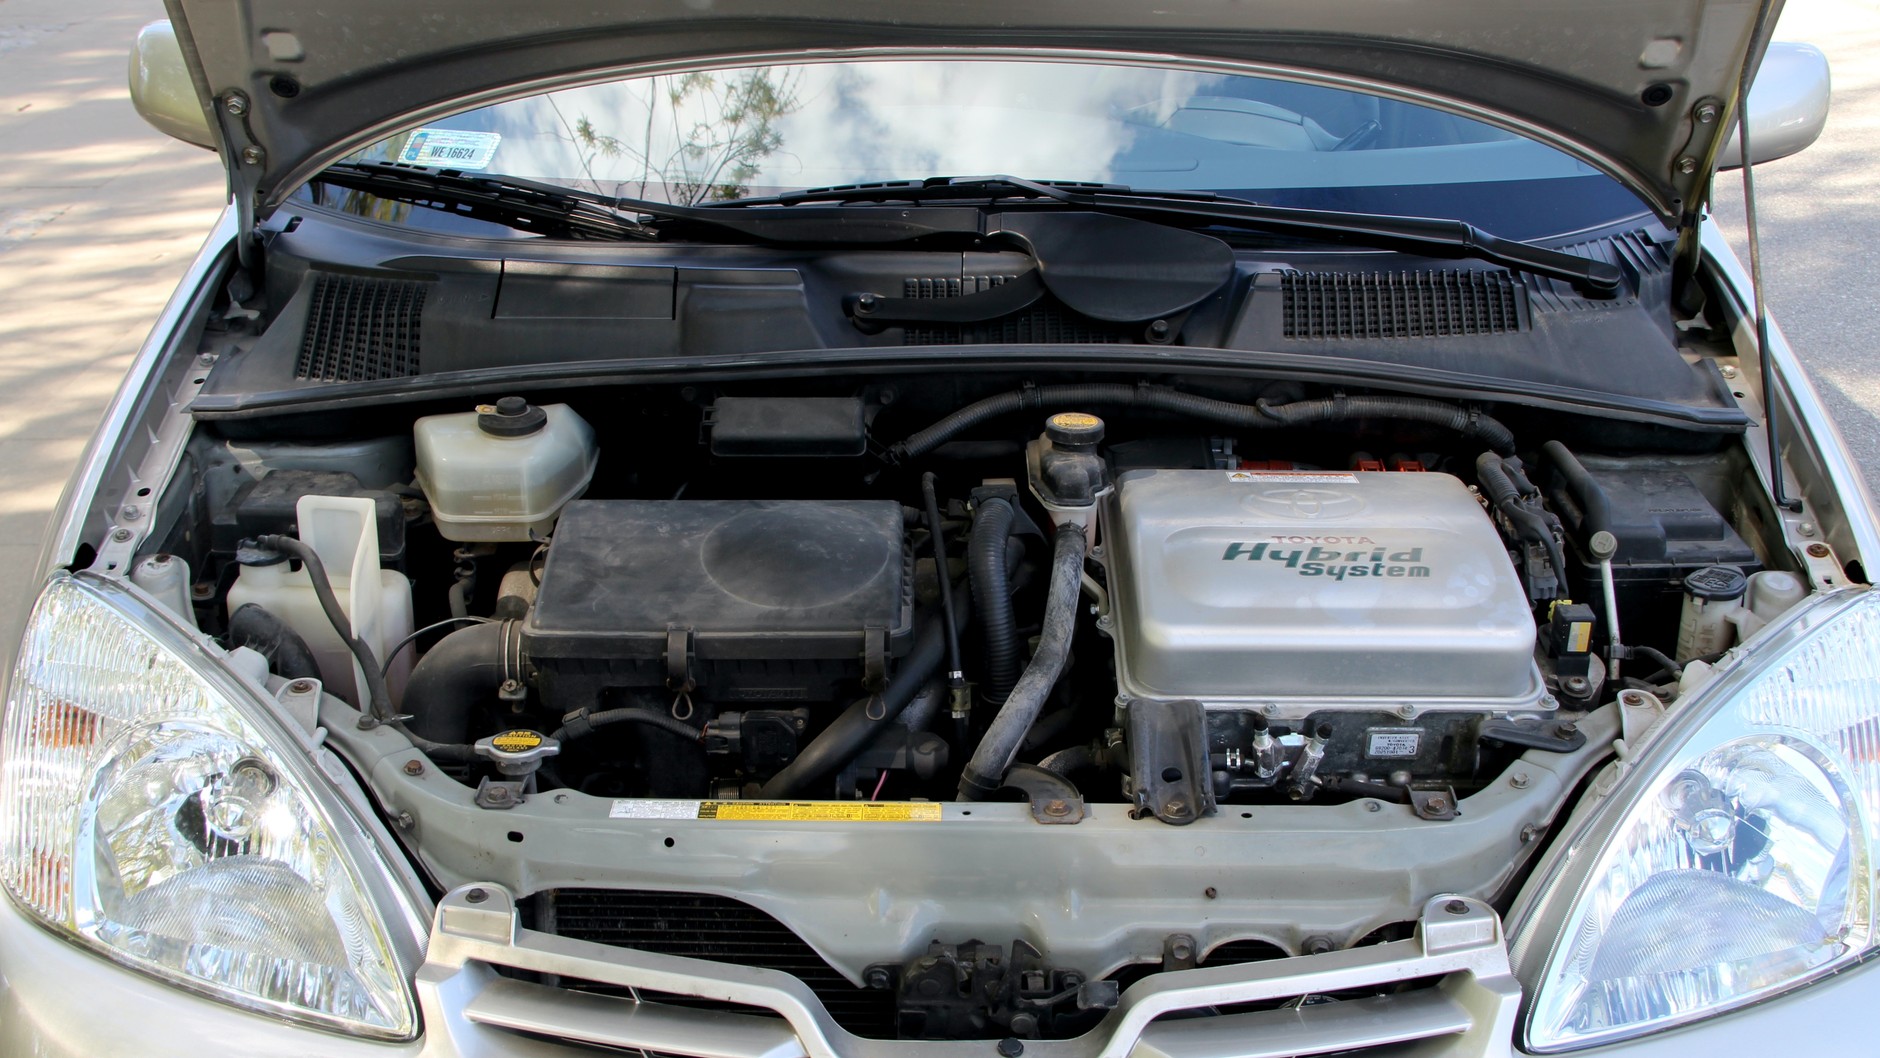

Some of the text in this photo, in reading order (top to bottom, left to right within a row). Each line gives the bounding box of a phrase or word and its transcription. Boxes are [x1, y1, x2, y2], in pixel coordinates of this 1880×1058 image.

[430, 147, 475, 159] WE 16624
[1271, 536, 1376, 544] TOYOTA
[1222, 543, 1423, 568] Hybrid
[1299, 563, 1430, 581] System
